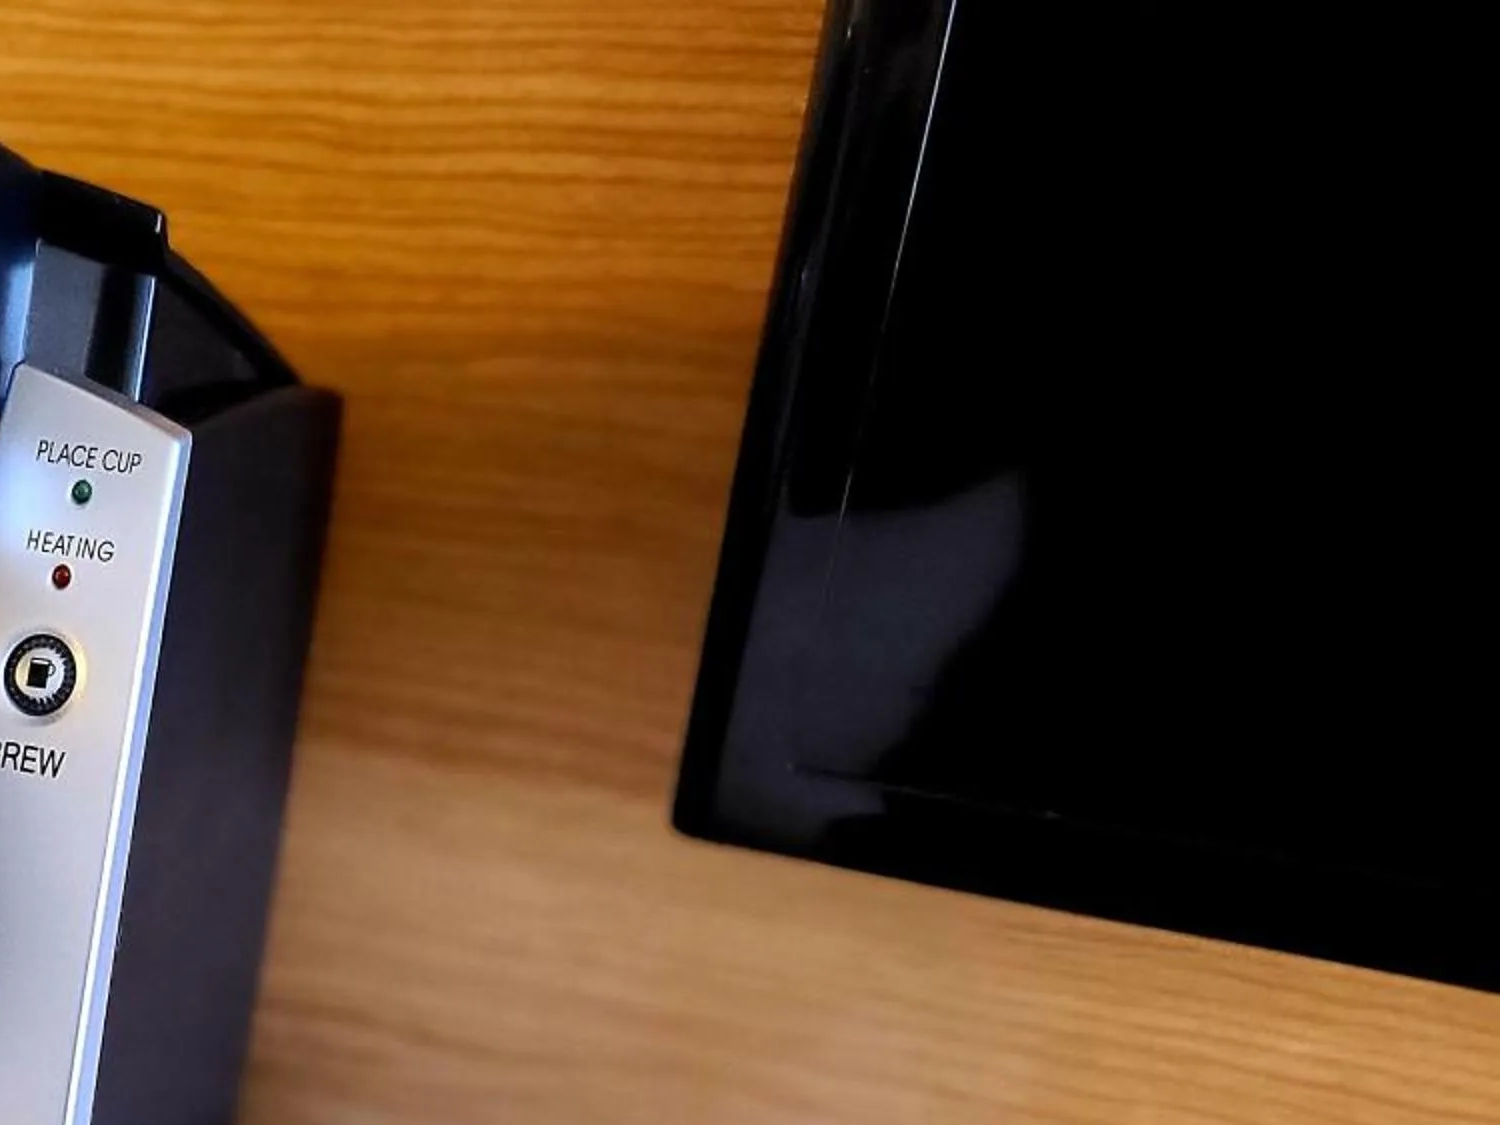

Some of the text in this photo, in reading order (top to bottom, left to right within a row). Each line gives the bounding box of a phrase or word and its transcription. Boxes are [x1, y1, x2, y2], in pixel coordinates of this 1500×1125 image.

[36, 438, 143, 475] PLACE CUP
[26, 529, 116, 563] HEATING
